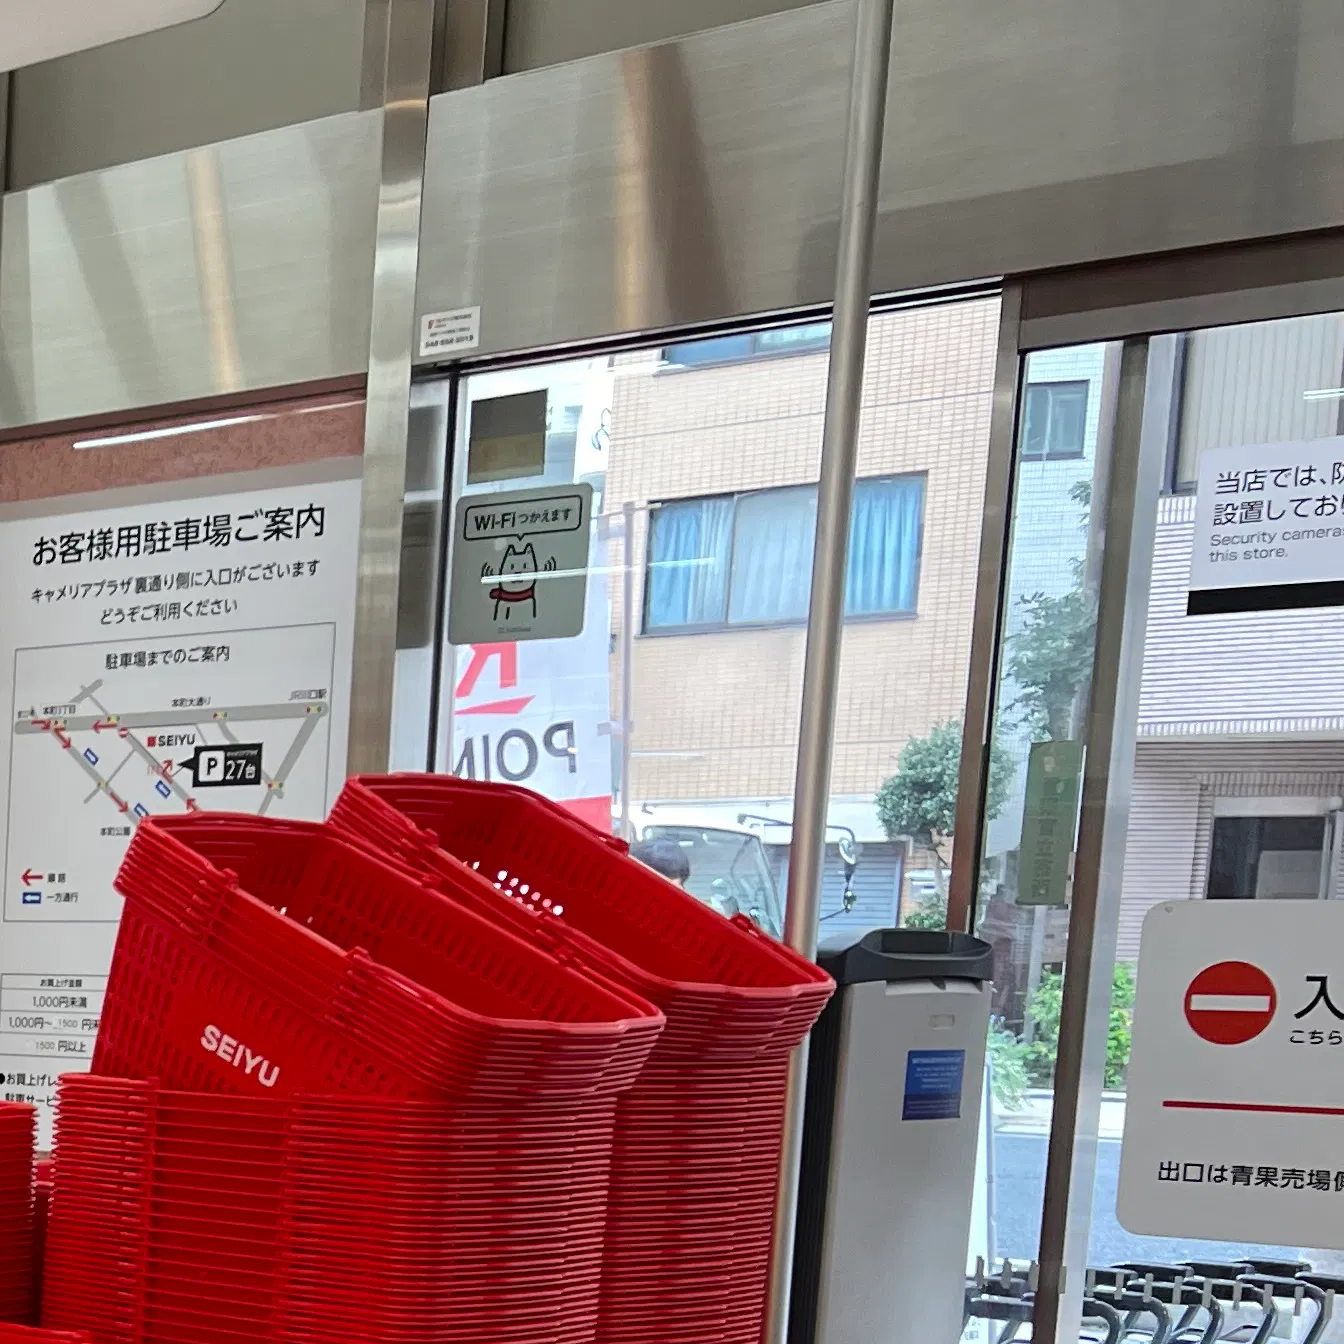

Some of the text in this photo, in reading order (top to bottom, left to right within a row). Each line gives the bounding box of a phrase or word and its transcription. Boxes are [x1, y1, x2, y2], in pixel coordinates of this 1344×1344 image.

[475, 507, 572, 532] Wi-Fi つかえます
[1213, 495, 1344, 526] 設置してお
[32, 503, 326, 566] お客様用駐車場ご案内
[1210, 527, 1344, 547] Security camera
[1209, 547, 1289, 563] this store.
[100, 599, 238, 625] どうぞご利用ください
[105, 645, 230, 670] 駐車場までのご案内
[158, 734, 196, 747] SEIYU
[206, 757, 256, 780] P 27台
[46, 892, 79, 903] 一方通行
[32, 996, 87, 1008] 1,000円未満
[200, 1024, 280, 1088] SEIYU
